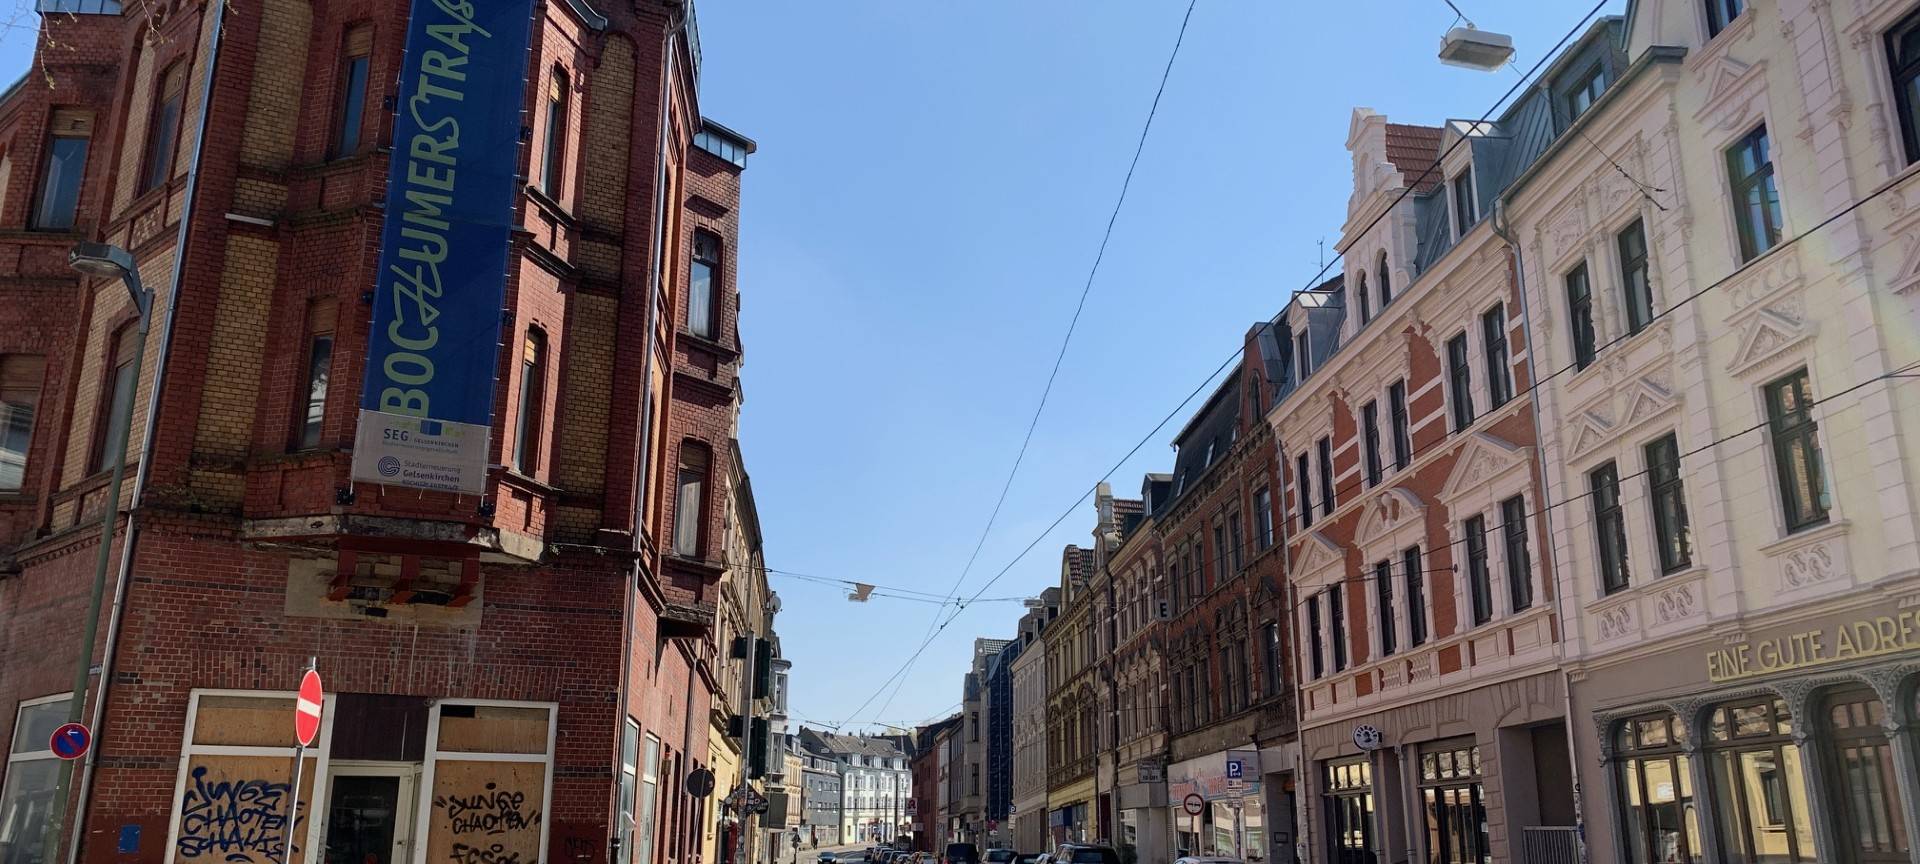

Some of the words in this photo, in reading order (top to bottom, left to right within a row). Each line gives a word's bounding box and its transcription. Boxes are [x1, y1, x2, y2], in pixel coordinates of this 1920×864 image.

[383, 428, 409, 441] SEG
[404, 459, 461, 473] Stadterneuerung
[403, 469, 460, 483] Gelsenkirchen
[1159, 602, 1168, 618] E
[1706, 644, 1753, 682] EINE
[1757, 629, 1826, 670] GUTE
[1229, 762, 1239, 777] P
